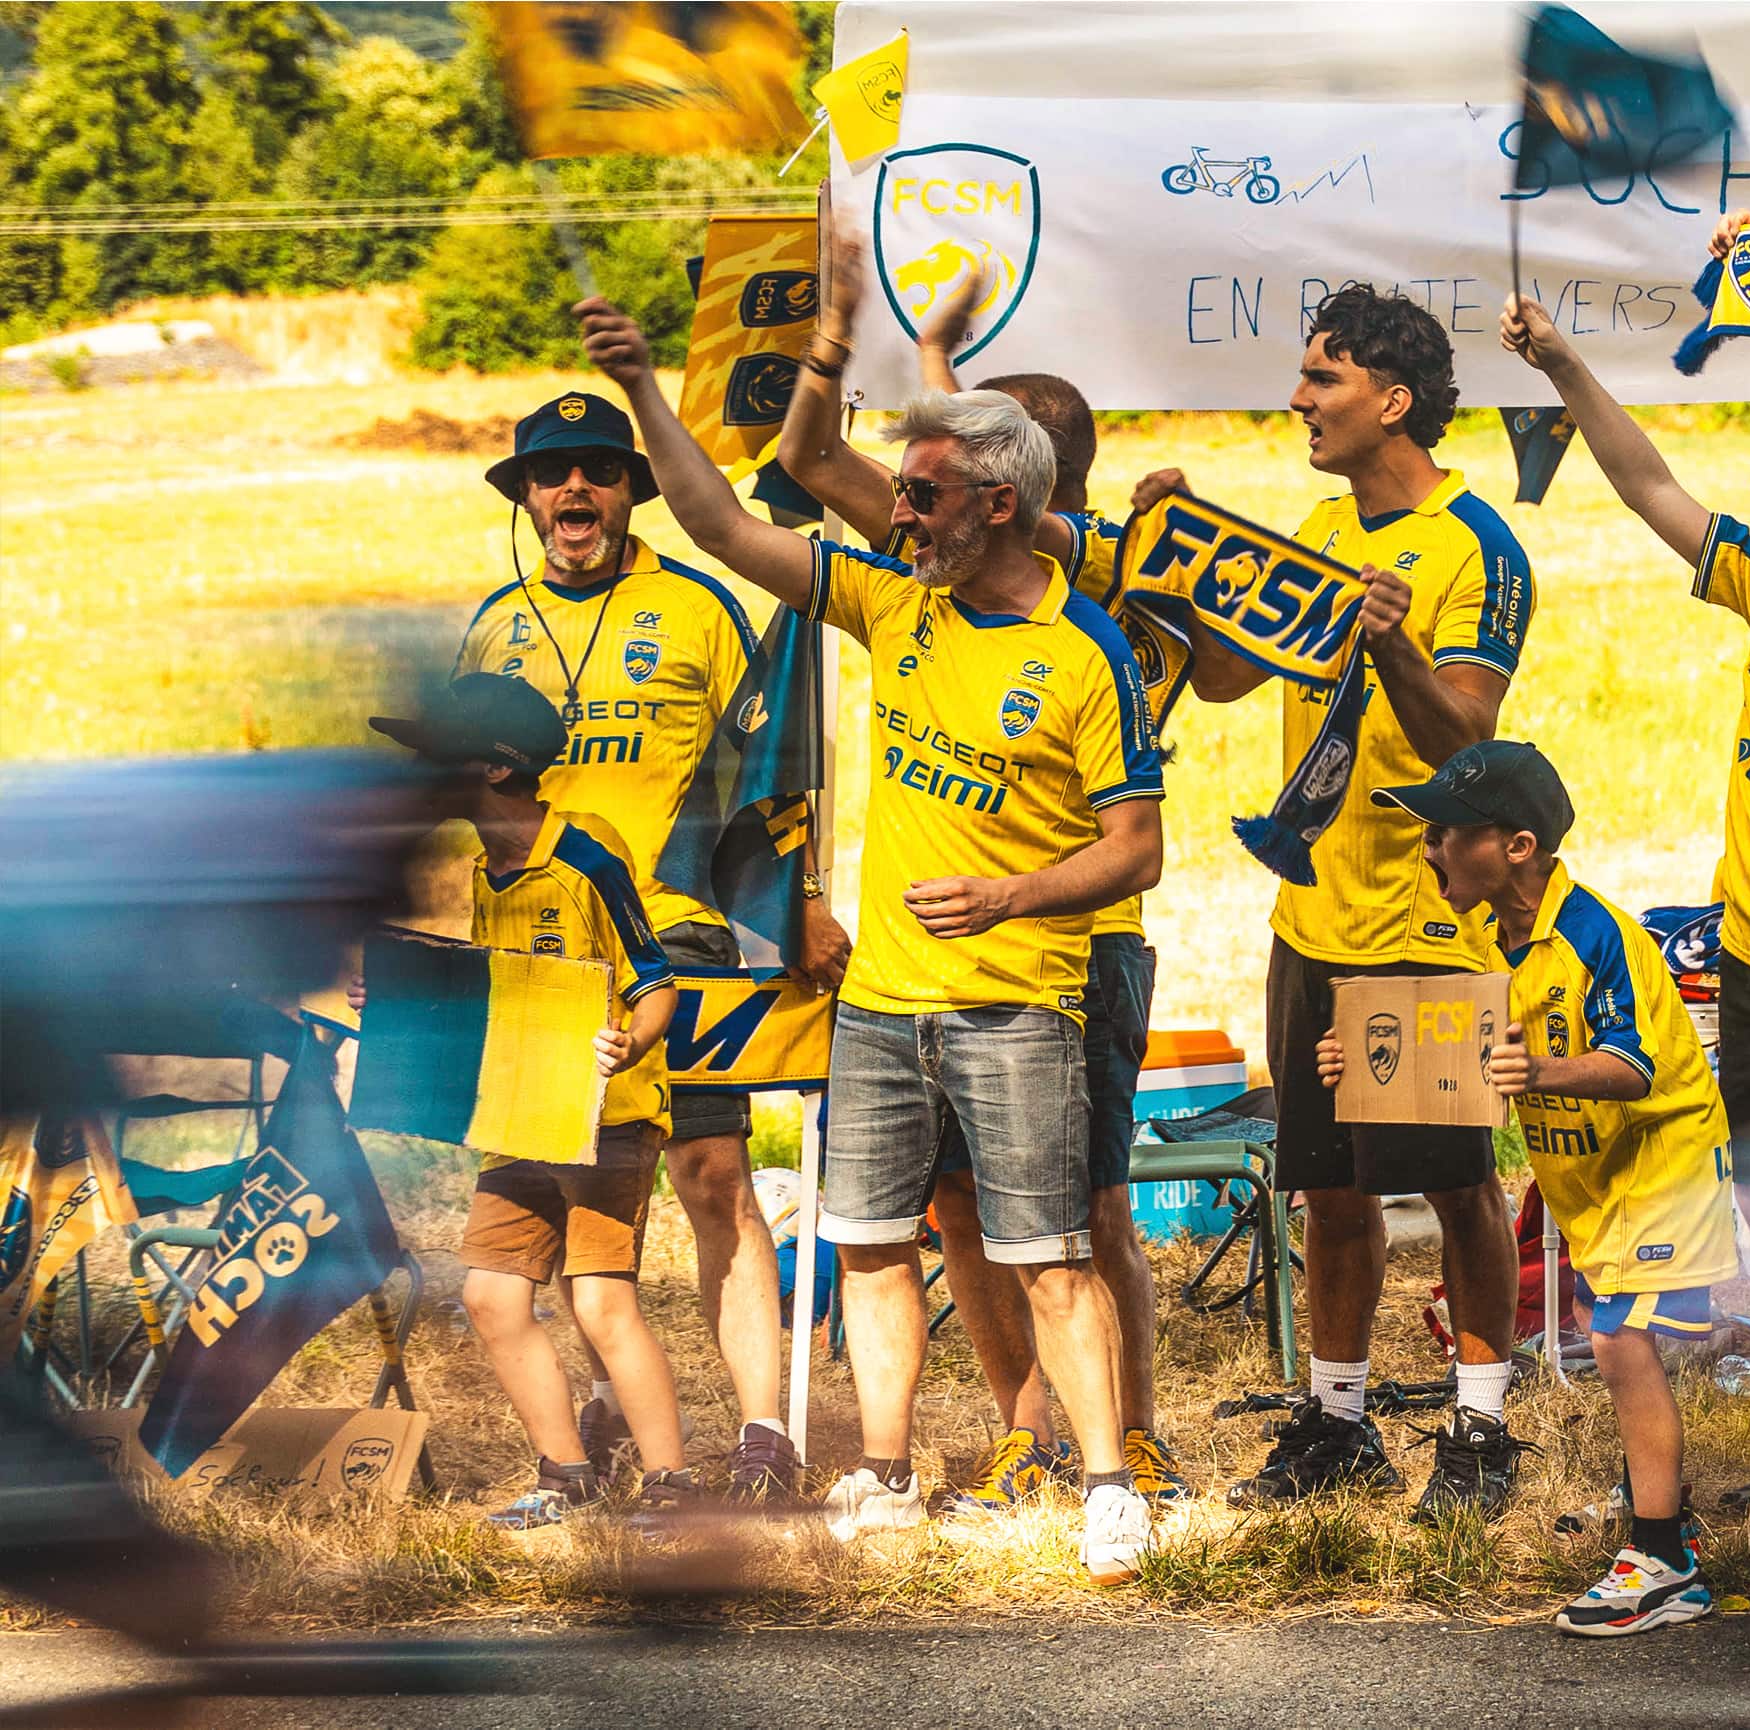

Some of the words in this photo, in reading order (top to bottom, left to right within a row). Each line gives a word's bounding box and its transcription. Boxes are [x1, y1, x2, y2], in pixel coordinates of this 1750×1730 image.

[892, 178, 1022, 216] FCSM
[1189, 275, 1263, 344] EN
[1300, 277, 1485, 338] RTE
[1533, 278, 1684, 337] VERS
[1138, 503, 1363, 664] FCSM
[1008, 692, 1039, 710] FCSM
[1369, 1025, 1398, 1038] FCSM
[1154, 1180, 1203, 1210] RIDE
[350, 1446, 390, 1457] FCSM
